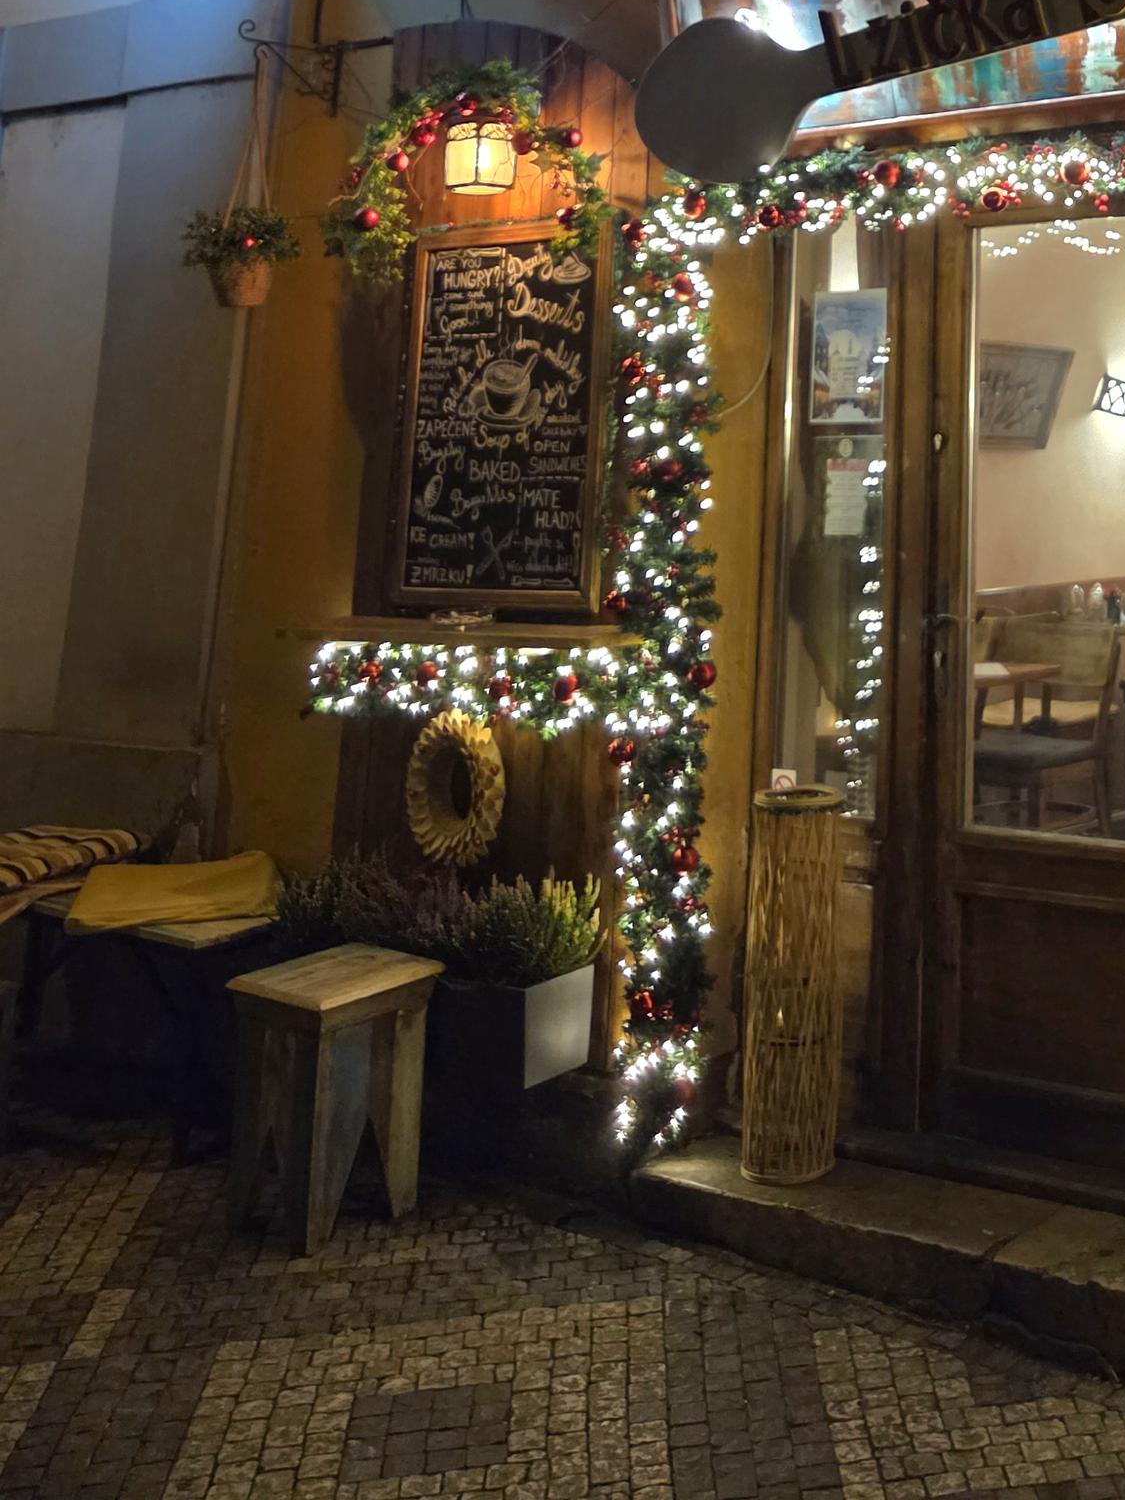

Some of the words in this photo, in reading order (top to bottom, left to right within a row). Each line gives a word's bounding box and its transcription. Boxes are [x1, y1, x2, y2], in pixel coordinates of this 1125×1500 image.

[436, 257, 457, 271] ARE
[460, 255, 483, 269] YOU
[444, 266, 500, 289] HUNGRY?
[507, 282, 586, 334] Desserts
[474, 424, 511, 461] Soup
[534, 440, 571, 453] OPEN
[469, 459, 521, 483] BAKED
[535, 509, 576, 530] HLAD?
